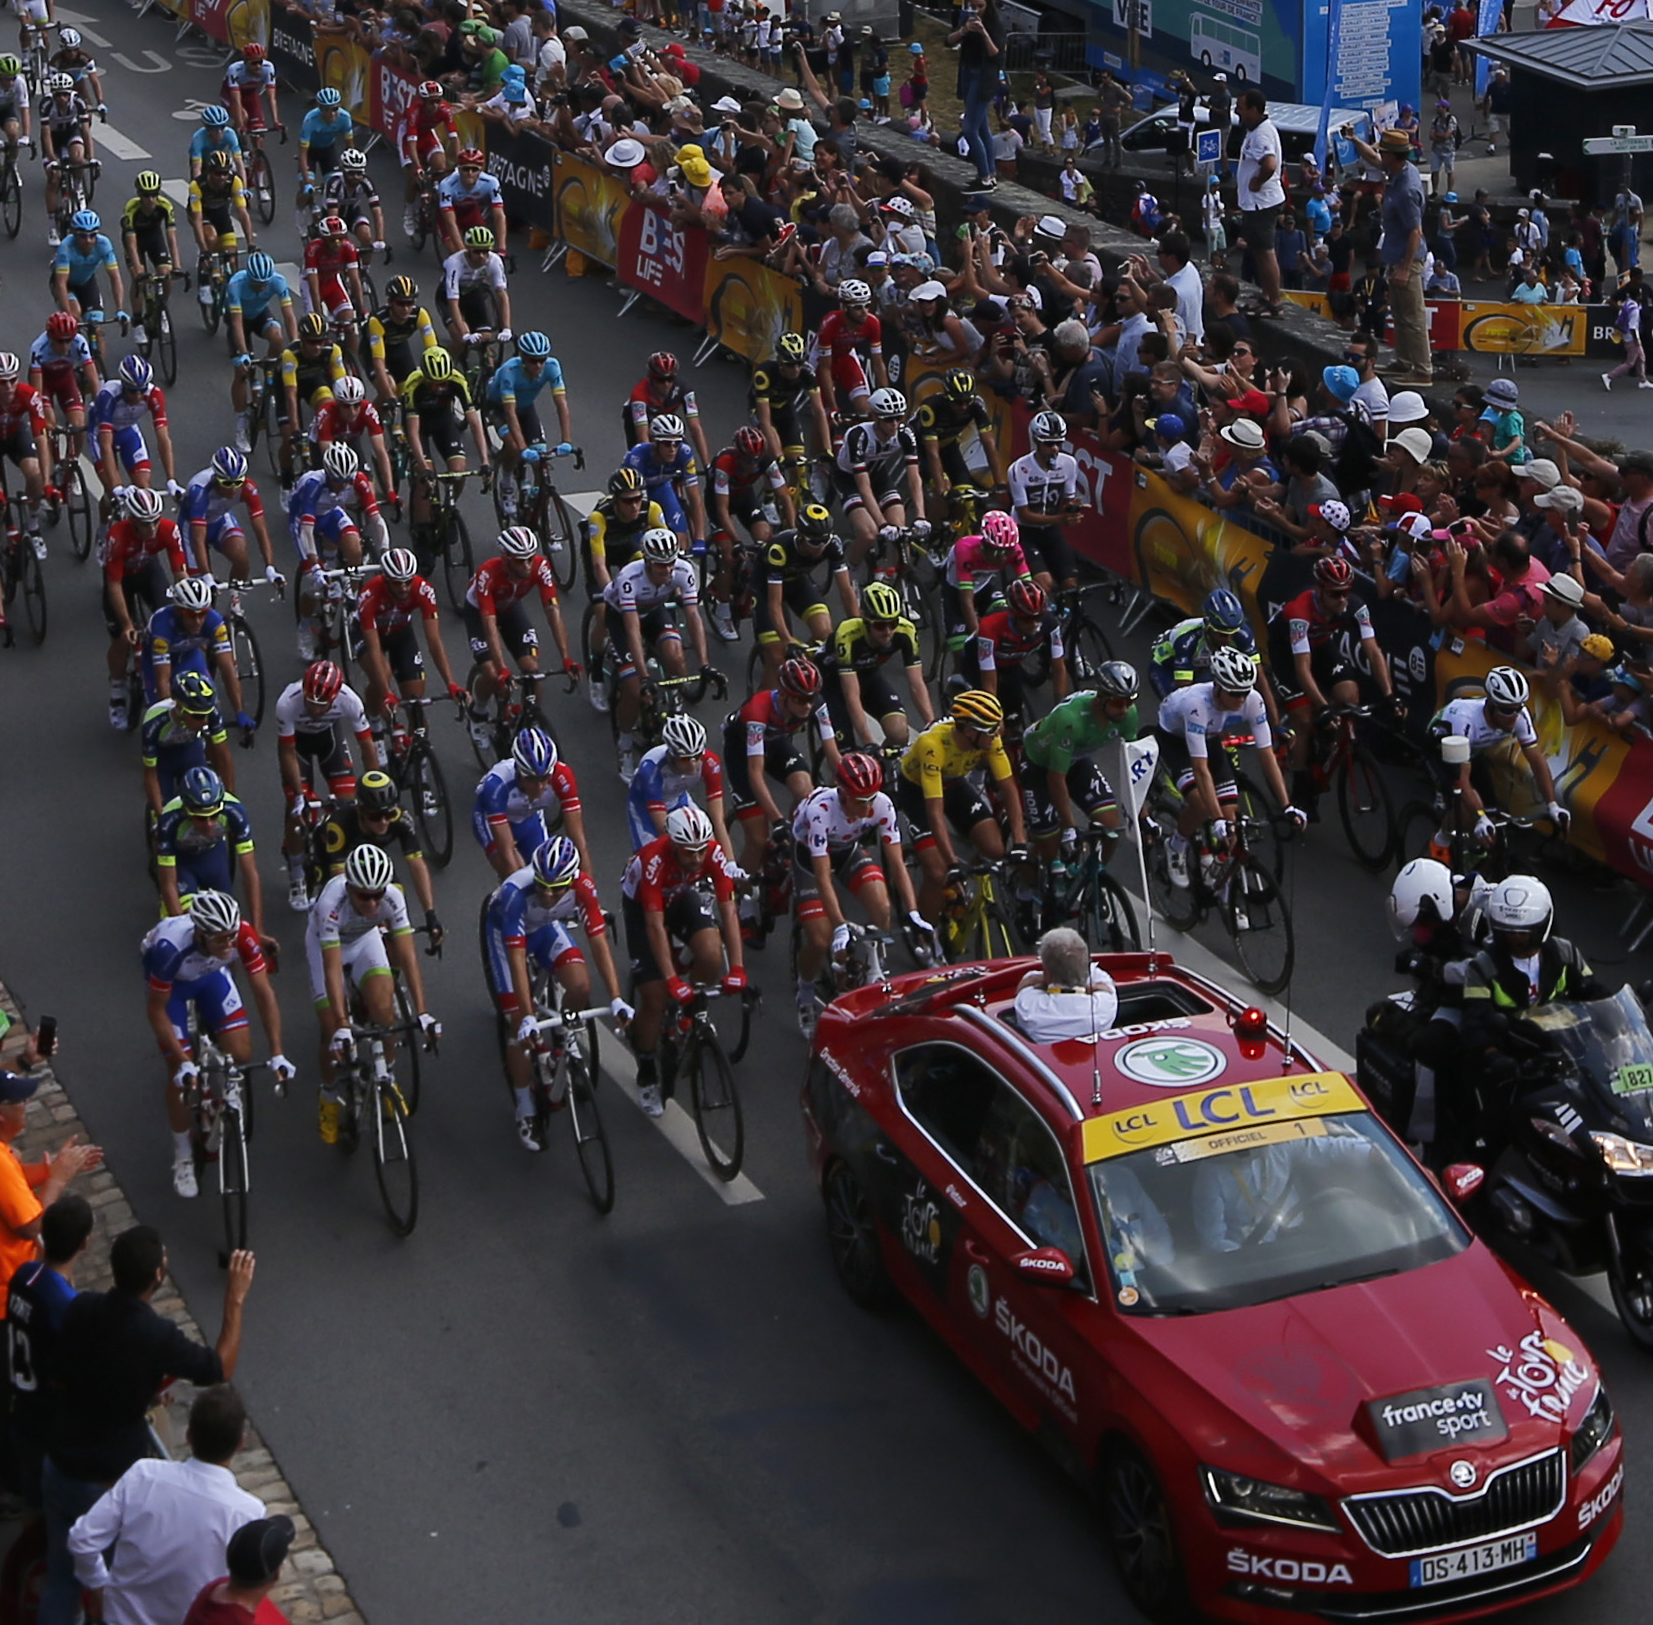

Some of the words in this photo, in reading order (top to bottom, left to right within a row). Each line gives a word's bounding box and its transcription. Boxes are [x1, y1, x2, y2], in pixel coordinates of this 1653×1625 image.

[273, 28, 314, 67] BRETAGNE
[489, 151, 544, 197] BRETAGNE
[636, 254, 663, 287] LIFE
[1024, 789, 1041, 825] BORA
[1290, 1081, 1329, 1097] LCL
[1626, 1068, 1653, 1085] 827
[1115, 1114, 1157, 1133] LCL
[1173, 1087, 1275, 1130] LCL
[1208, 1132, 1267, 1150] OFFICIEL
[1294, 1122, 1306, 1135] 1
[1020, 1258, 1065, 1272] ŠKODA
[995, 1297, 1076, 1403] ŠKODA
[1437, 1411, 1491, 1439] sport
[1227, 1547, 1353, 1584] ŠKODA
[1422, 1539, 1527, 1585] DS-413-MH
